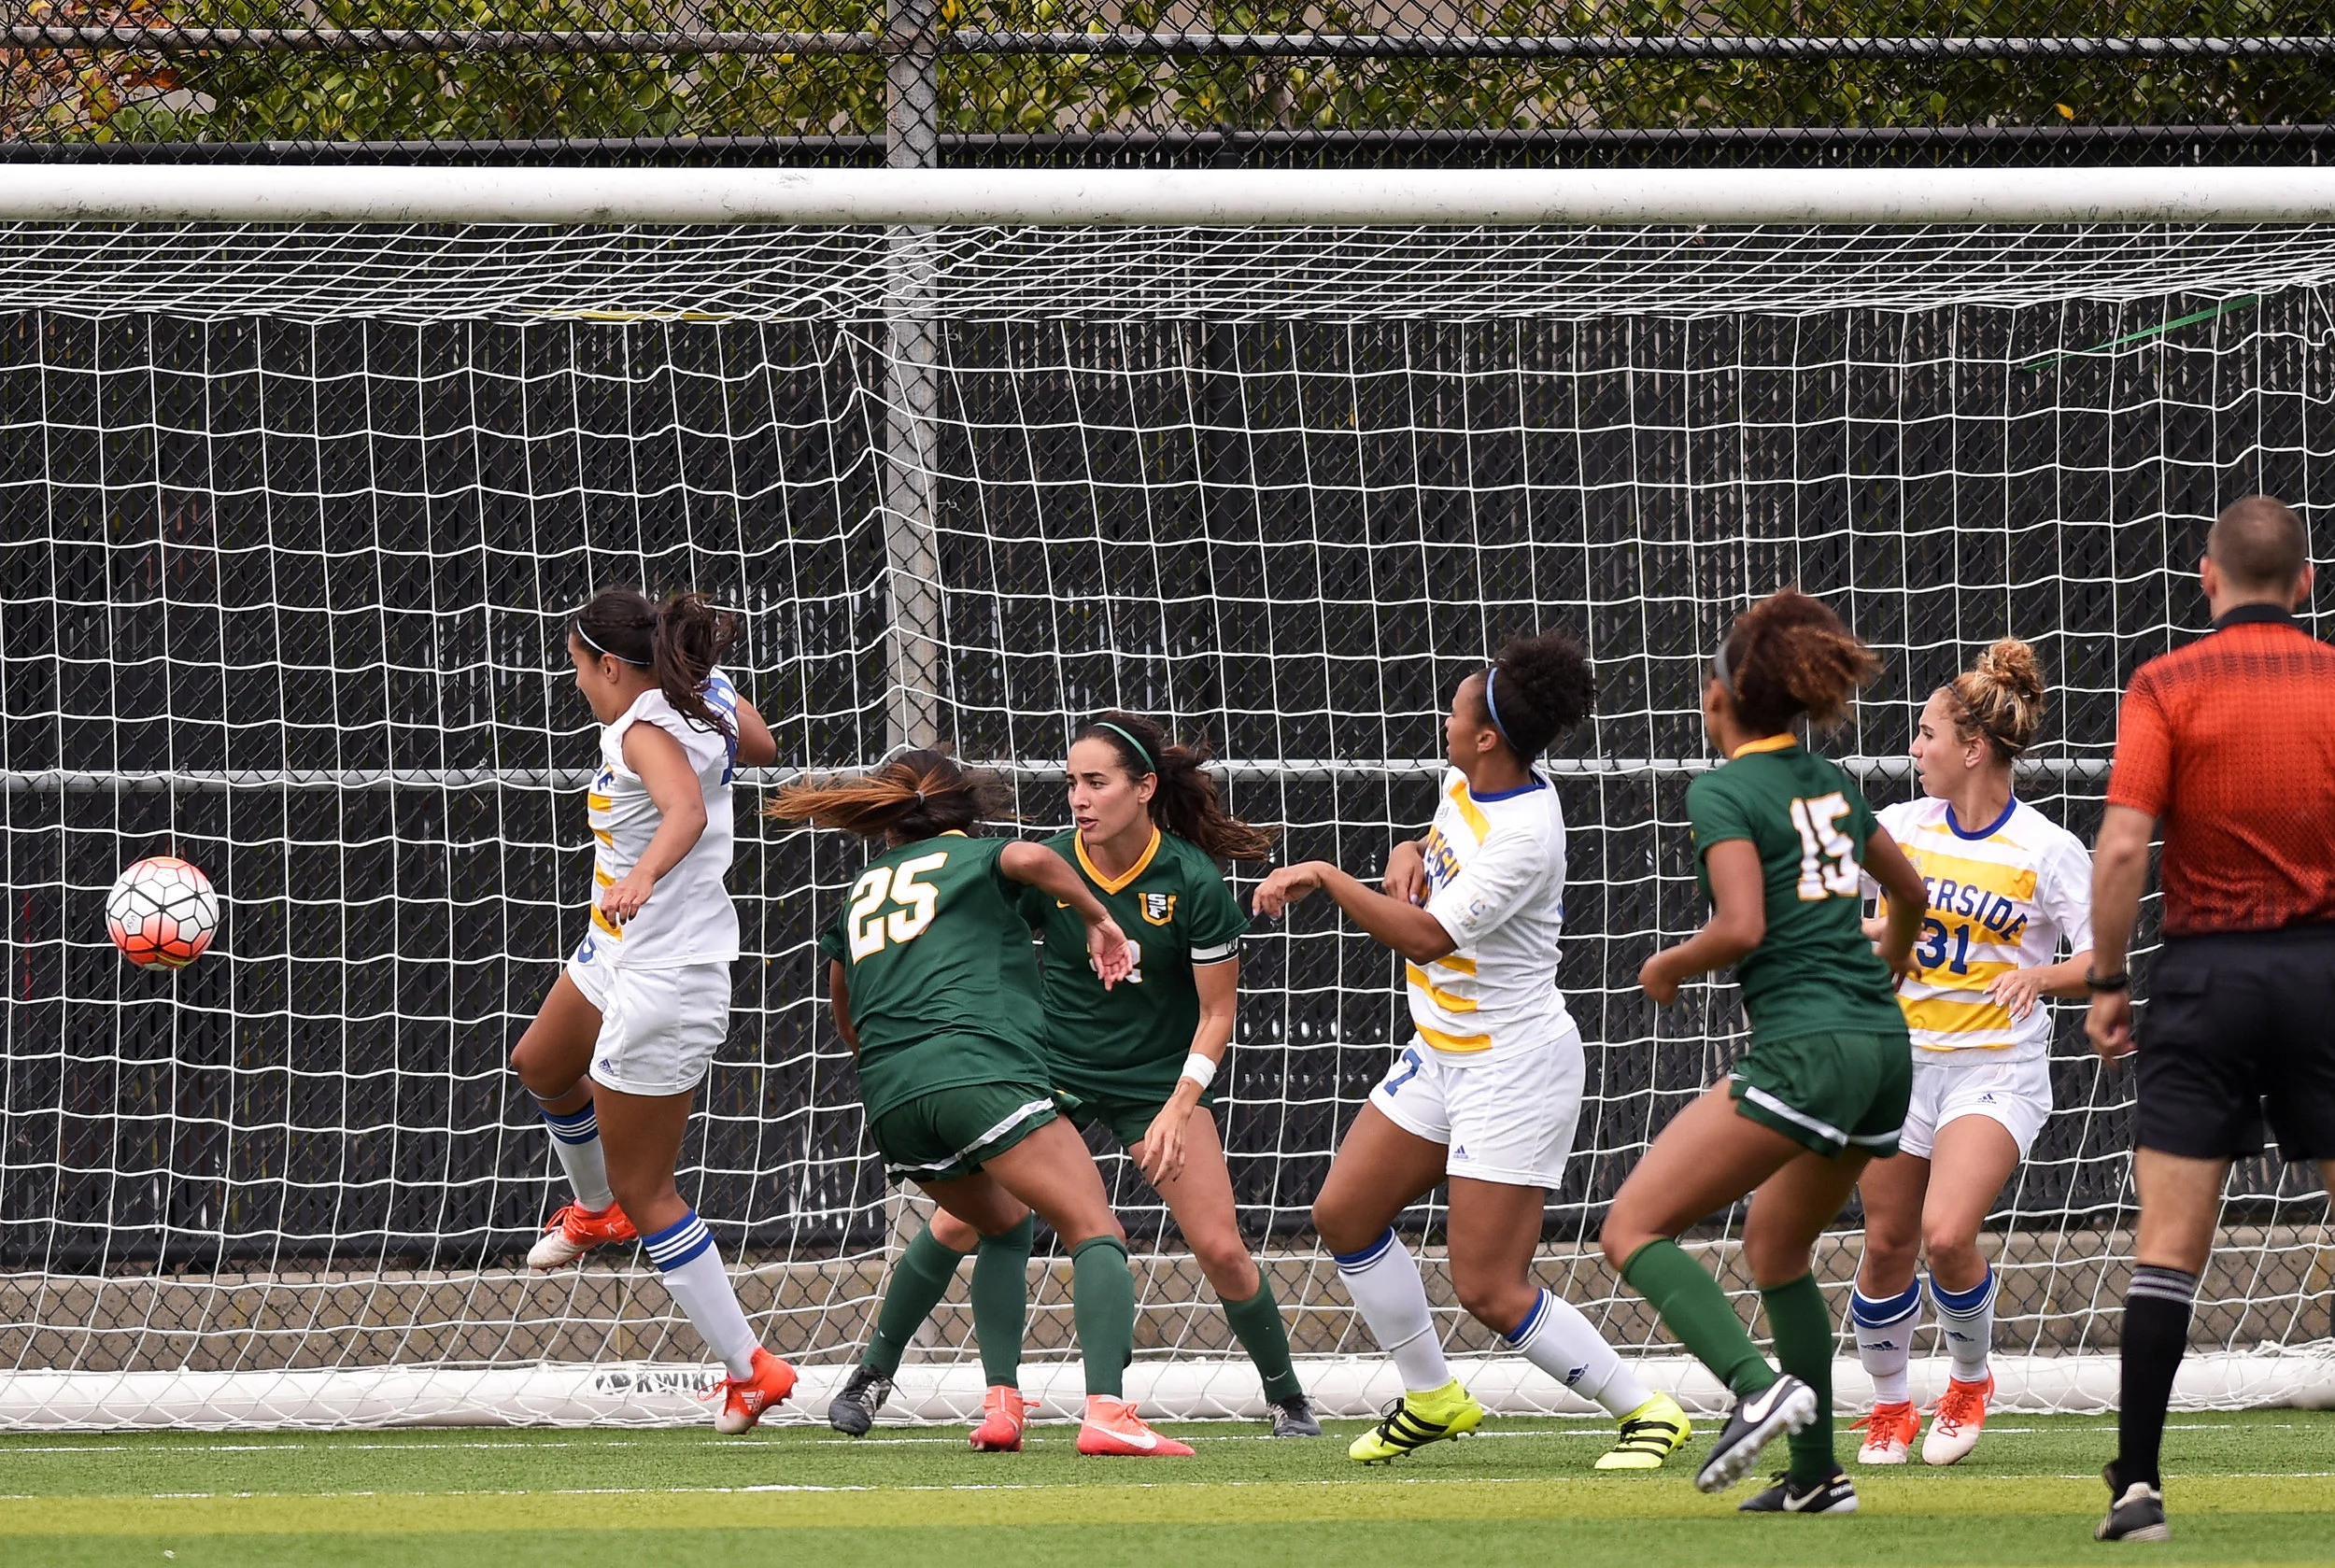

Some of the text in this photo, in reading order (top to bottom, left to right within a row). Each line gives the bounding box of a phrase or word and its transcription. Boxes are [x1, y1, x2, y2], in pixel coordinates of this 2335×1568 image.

[1790, 792, 1860, 900] 15
[848, 852, 948, 966] 25
[1923, 876, 2029, 941] ERSIDE
[1917, 917, 1969, 974] 31
[1383, 1048, 1422, 1097] 7
